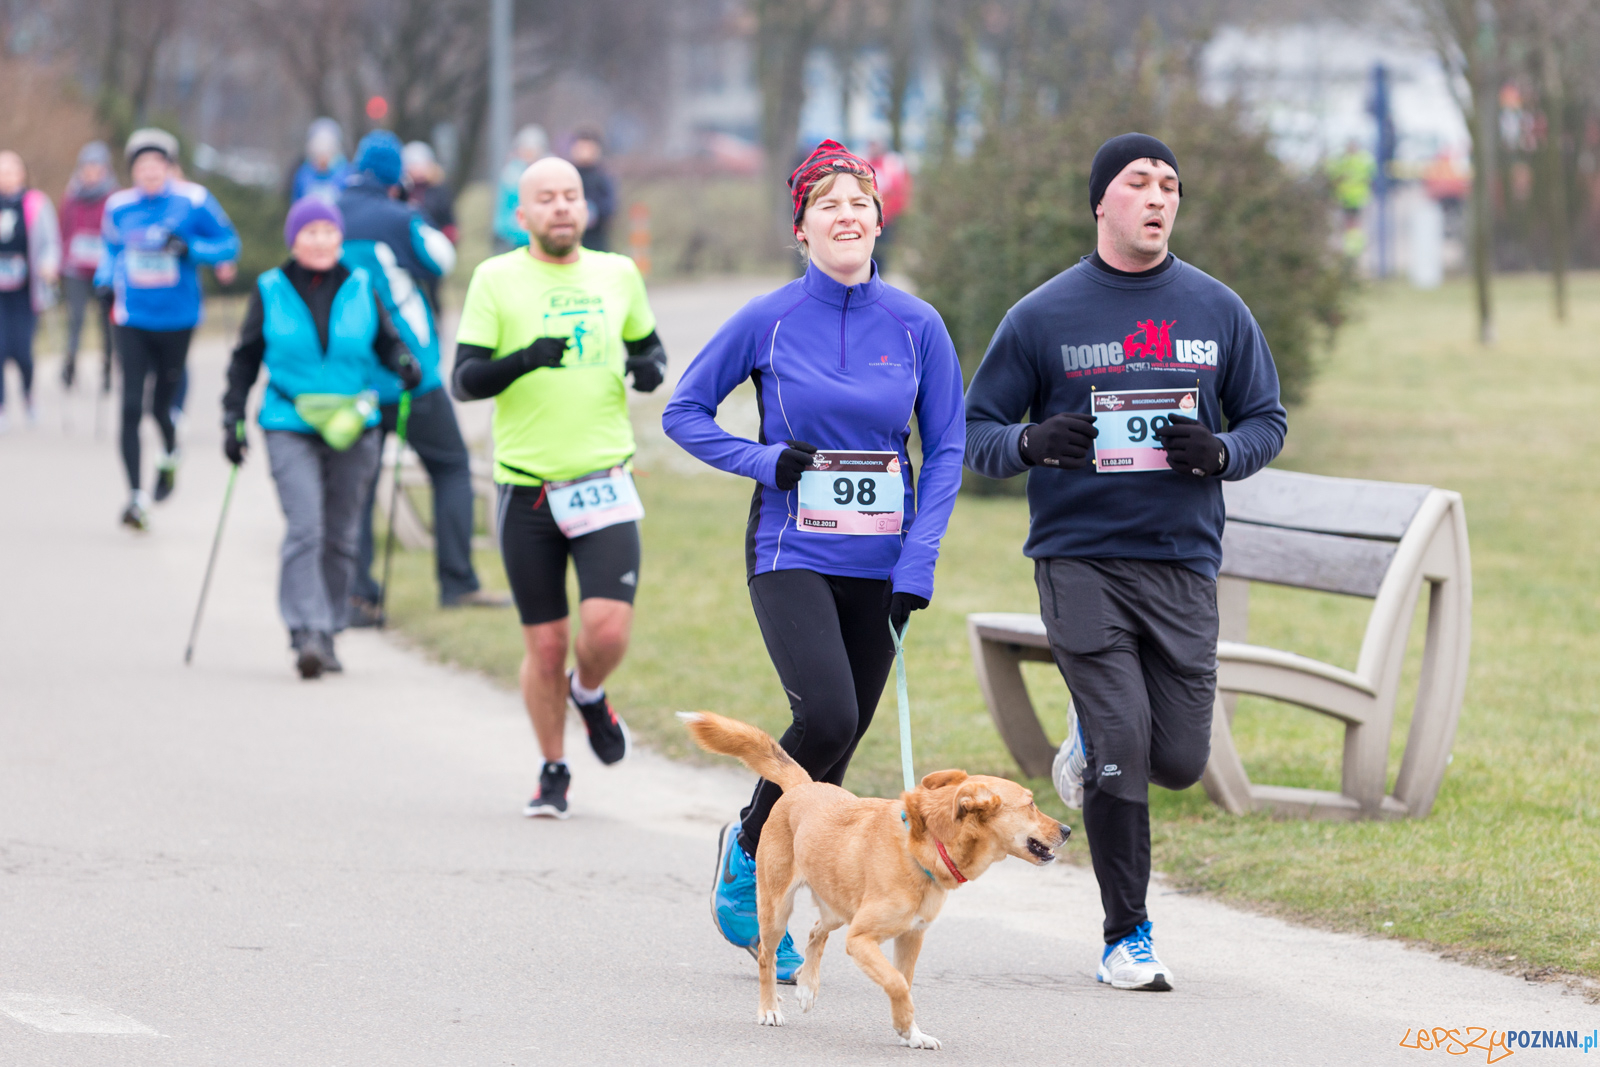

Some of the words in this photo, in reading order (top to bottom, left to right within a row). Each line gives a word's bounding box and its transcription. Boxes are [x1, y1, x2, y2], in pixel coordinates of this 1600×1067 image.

[1061, 341, 1124, 371] bone
[1176, 339, 1218, 366] usa
[569, 484, 617, 508] 433
[833, 477, 876, 505] 98
[804, 519, 836, 527] 11.02.2018
